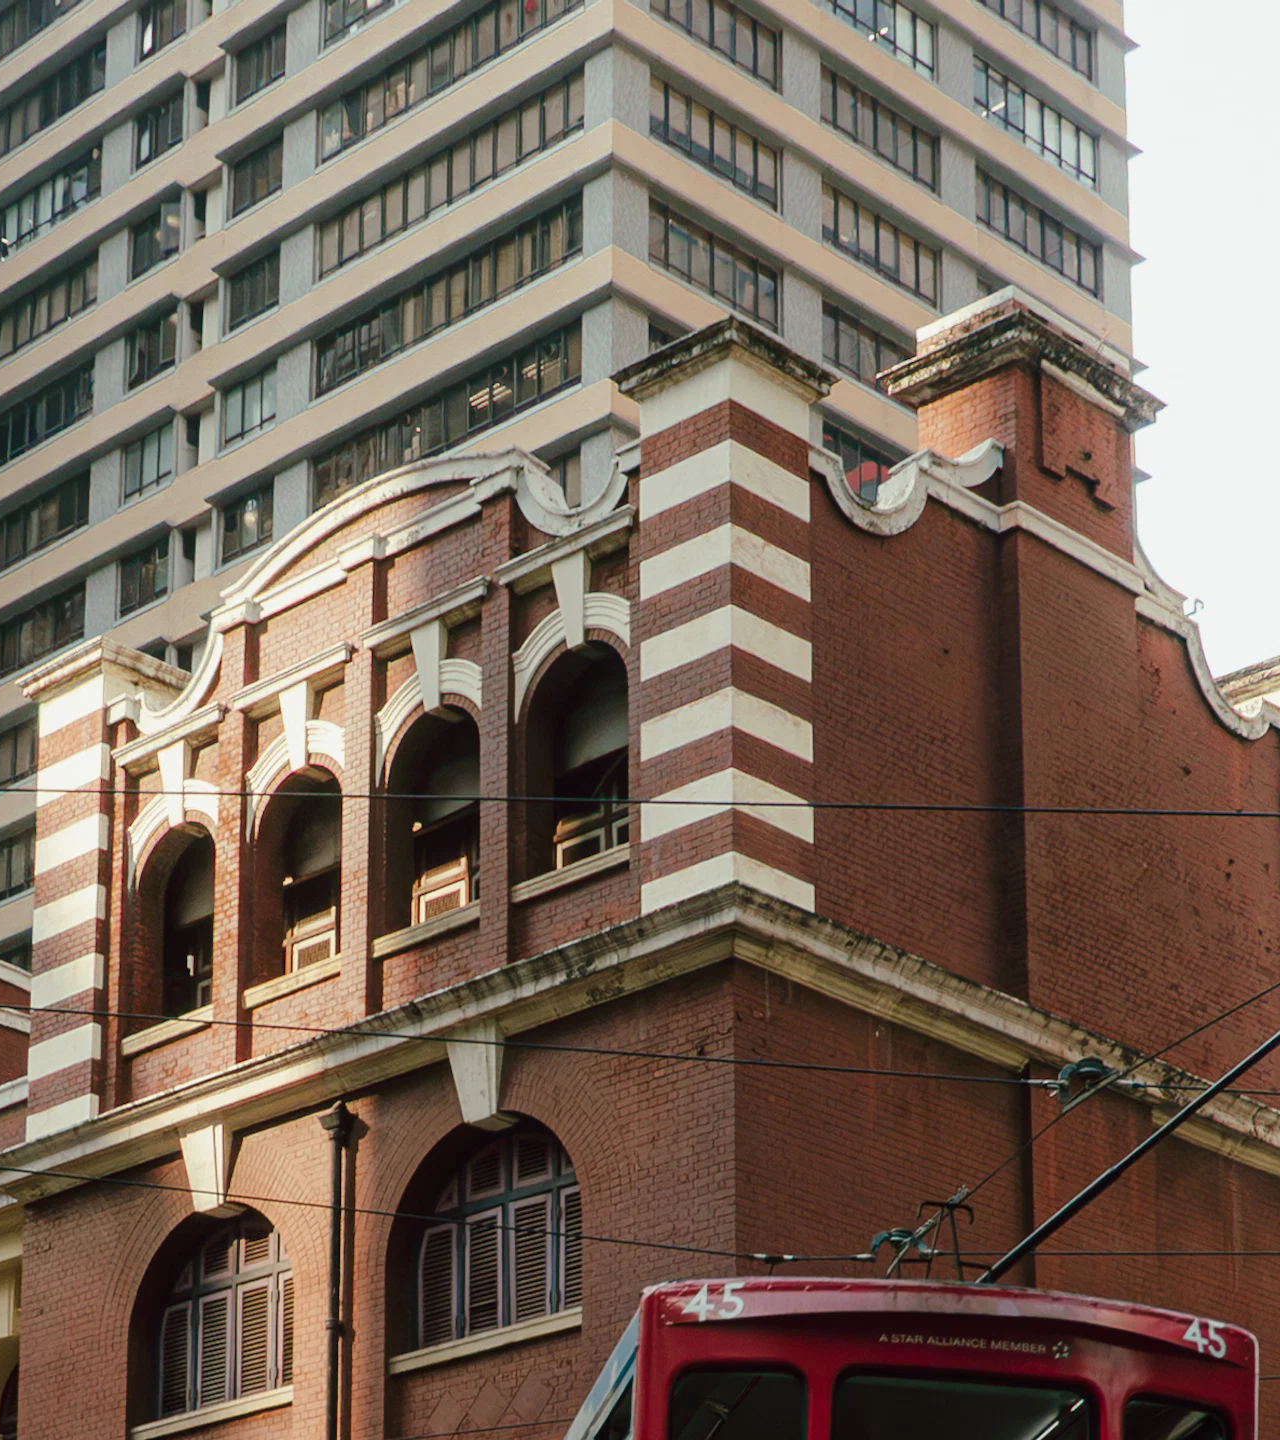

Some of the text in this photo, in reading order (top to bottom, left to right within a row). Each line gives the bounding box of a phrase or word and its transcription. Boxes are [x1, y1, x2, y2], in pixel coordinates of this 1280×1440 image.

[681, 1282, 745, 1322] 45
[879, 1333, 1047, 1354] A STAR ALLIANCE MEMBER
[1183, 1318, 1226, 1358] 45
